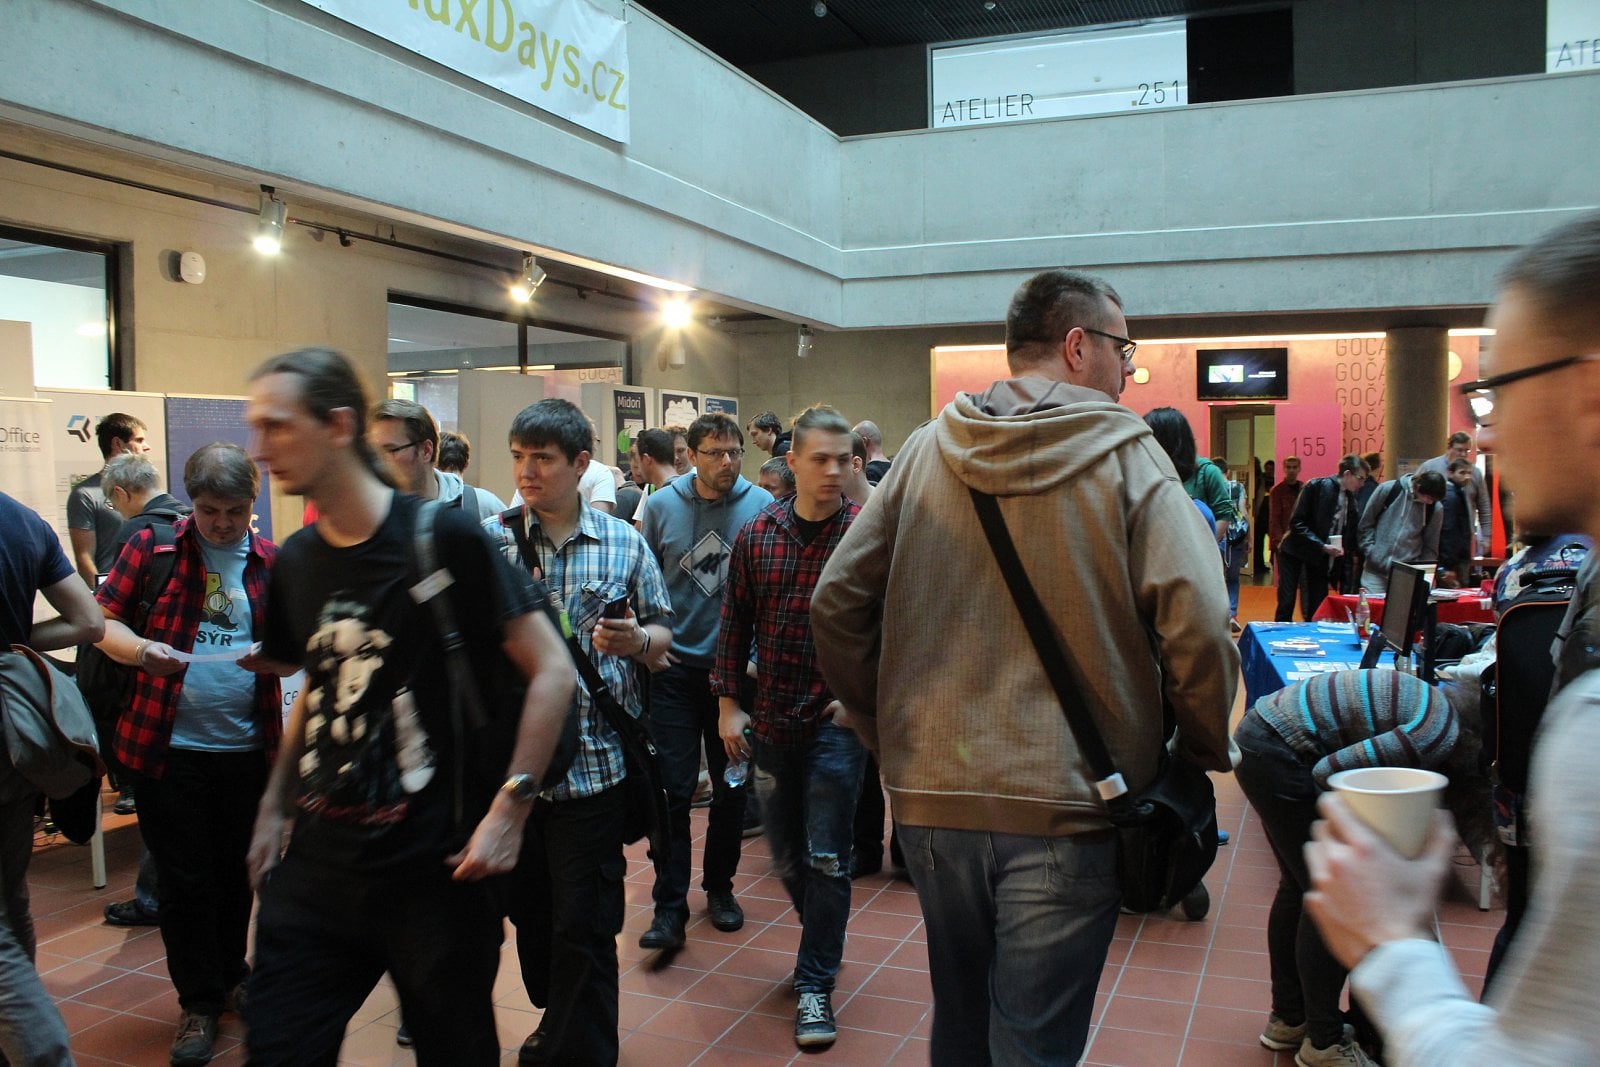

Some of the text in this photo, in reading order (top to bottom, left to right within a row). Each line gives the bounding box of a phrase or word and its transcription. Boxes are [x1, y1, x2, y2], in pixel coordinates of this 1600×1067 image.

[408, 0, 627, 110] uxDays.cz
[942, 80, 1179, 123] ATELIER 251
[617, 395, 641, 409] Midori
[1291, 437, 1326, 457] 155
